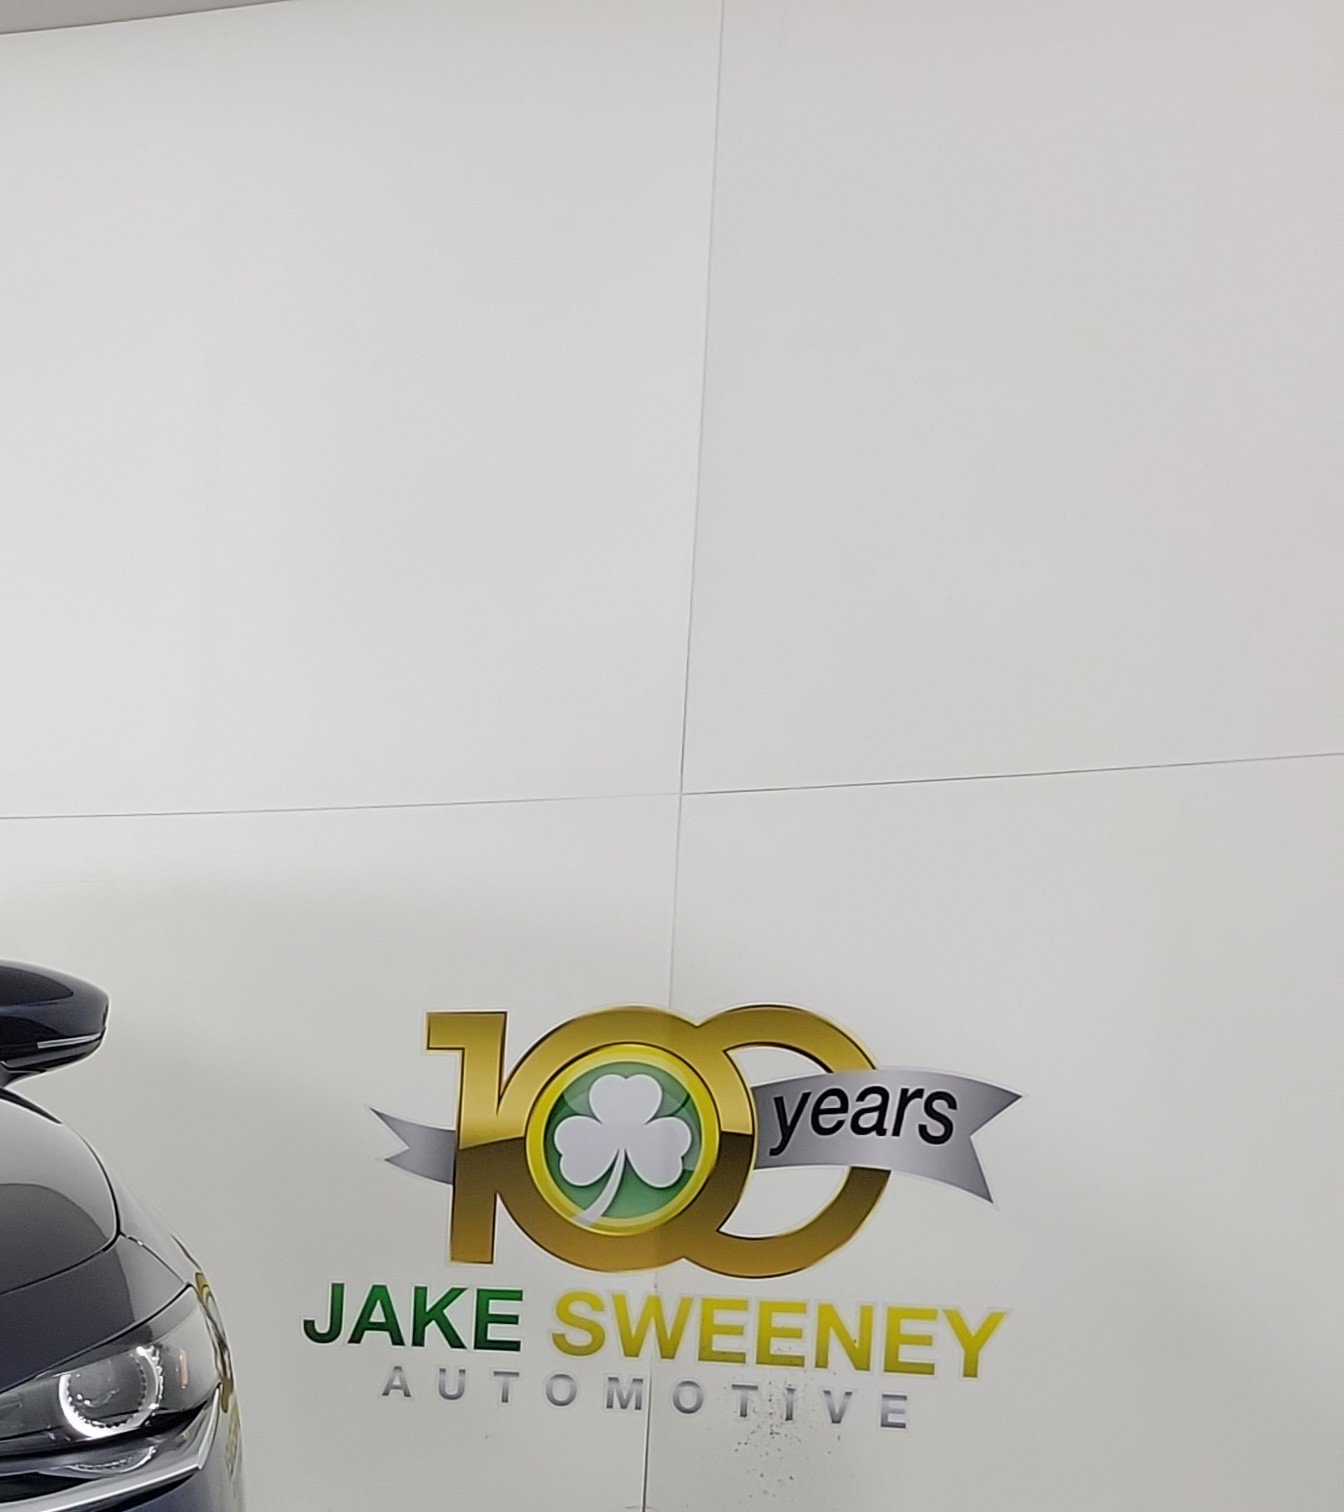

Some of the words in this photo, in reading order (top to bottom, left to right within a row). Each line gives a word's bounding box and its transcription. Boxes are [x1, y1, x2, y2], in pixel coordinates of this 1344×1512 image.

[425, 1004, 891, 1279] 100
[768, 1083, 959, 1157] years
[302, 1281, 524, 1353] JAKE
[550, 1290, 1006, 1379] SWEENEY
[380, 1365, 909, 1430] AUTOMOTIVE
